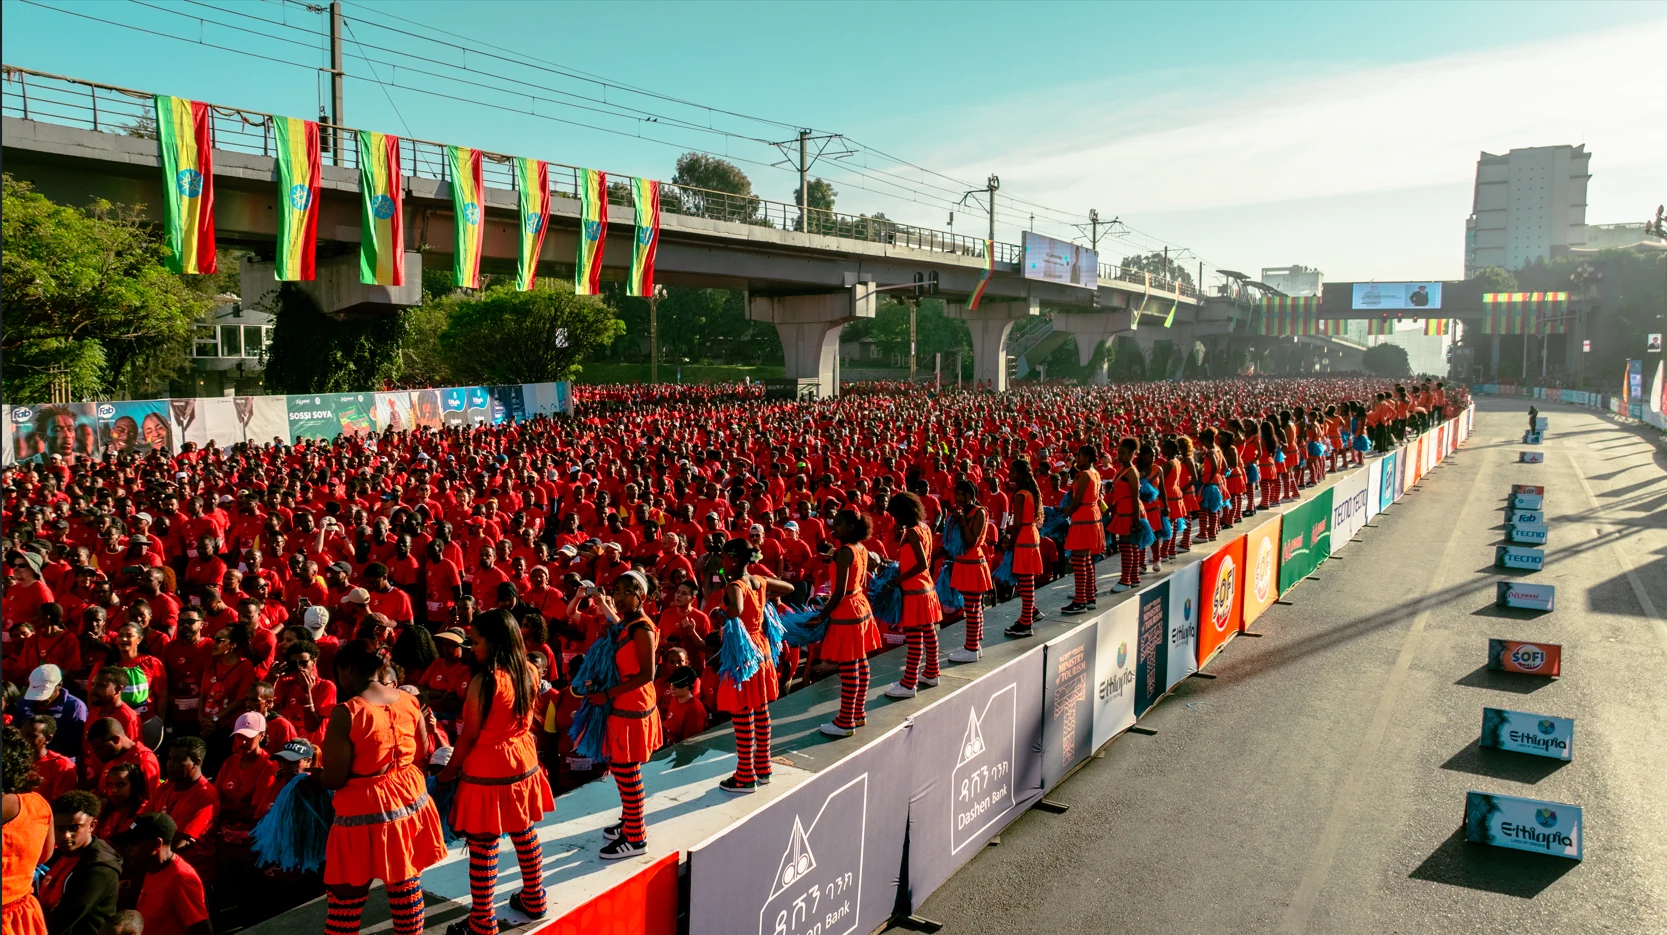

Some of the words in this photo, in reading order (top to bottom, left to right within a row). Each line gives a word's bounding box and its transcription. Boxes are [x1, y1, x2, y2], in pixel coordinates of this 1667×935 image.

[13, 409, 31, 420] Fab
[100, 405, 113, 416] Fab
[289, 412, 311, 420] SOSSI
[313, 411, 332, 419] SOYA
[1333, 497, 1352, 529] TECNO
[1519, 514, 1536, 523] Fab
[1515, 530, 1545, 538] TECNO
[1508, 554, 1541, 563] TECNO
[1213, 566, 1235, 620] SOFI
[1058, 651, 1085, 673] MINISTRY
[1512, 652, 1545, 662] SOFI
[1509, 730, 1567, 751] Ethiopia
[958, 800, 990, 831] Dashen
[992, 784, 1008, 804] Bank
[1501, 821, 1572, 850] Ethiopia
[825, 900, 851, 929] Bank
